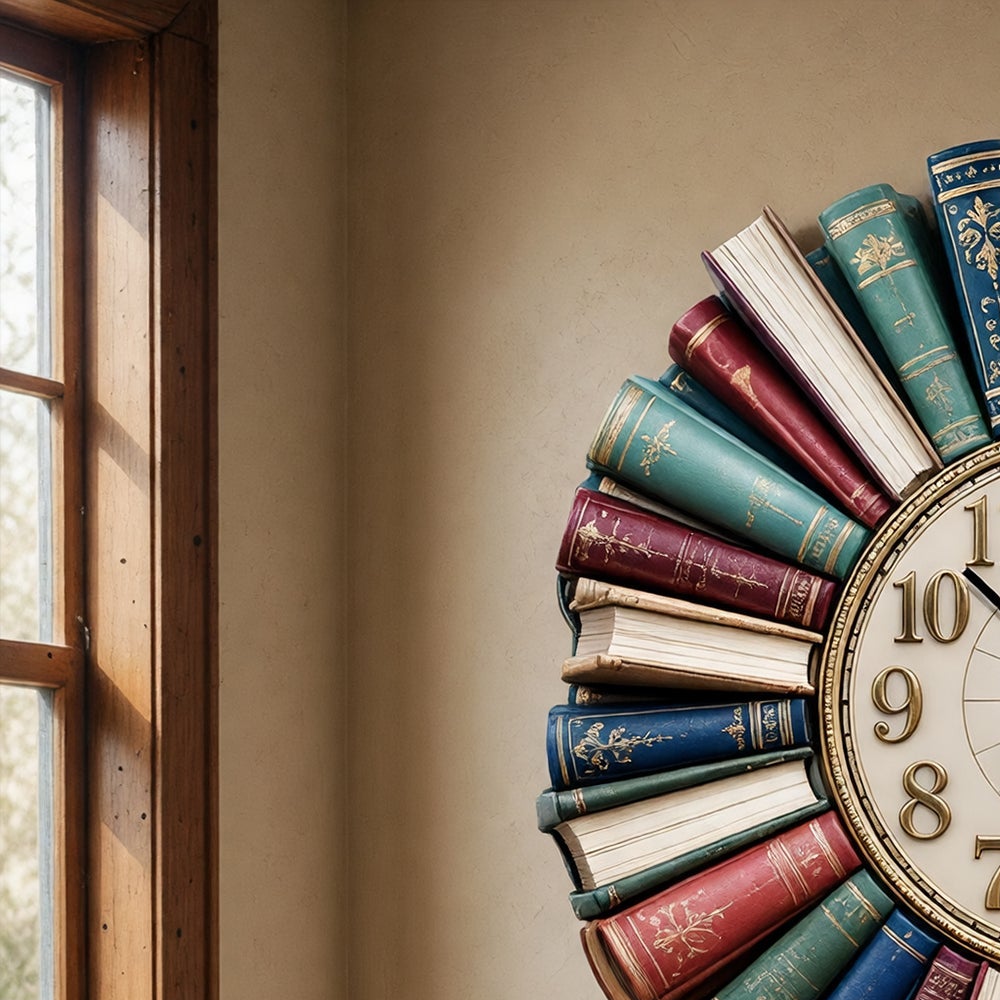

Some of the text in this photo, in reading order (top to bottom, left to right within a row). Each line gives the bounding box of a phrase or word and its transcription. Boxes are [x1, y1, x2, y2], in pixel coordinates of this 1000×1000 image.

[893, 569, 970, 644] 10
[871, 665, 923, 744] 9
[900, 760, 952, 839] 8
